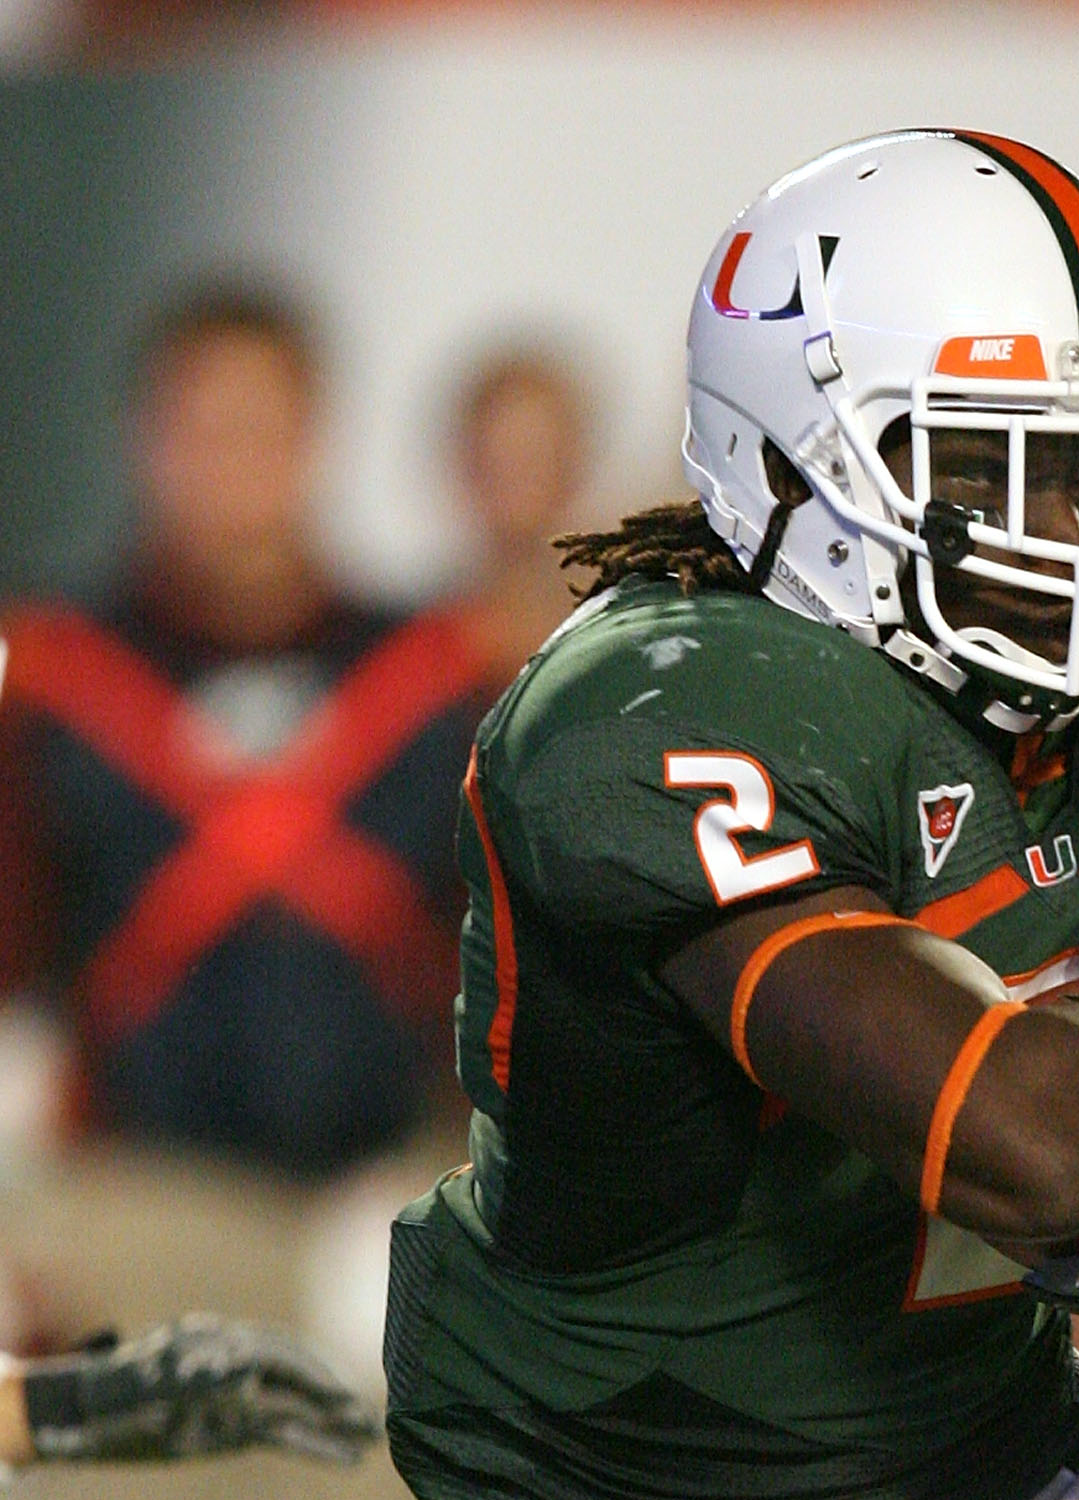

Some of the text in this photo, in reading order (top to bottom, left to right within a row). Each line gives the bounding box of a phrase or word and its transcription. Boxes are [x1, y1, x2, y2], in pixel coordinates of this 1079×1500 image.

[969, 338, 1015, 362] NIKE
[663, 749, 821, 908] 2
[1025, 834, 1078, 888] U
